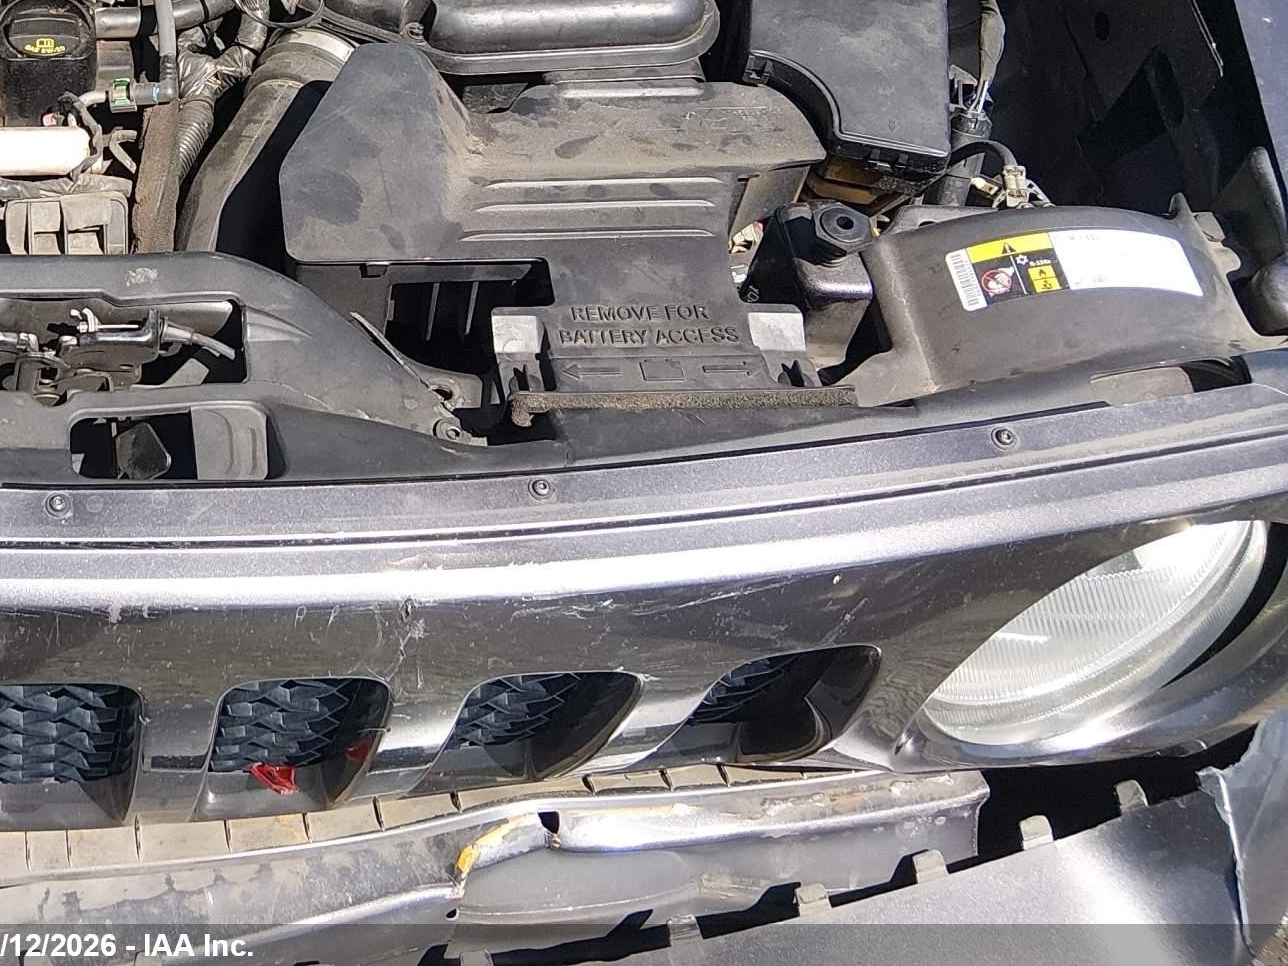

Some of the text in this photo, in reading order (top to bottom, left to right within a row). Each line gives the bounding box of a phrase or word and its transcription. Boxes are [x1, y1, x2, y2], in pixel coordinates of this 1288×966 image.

[570, 304, 710, 322] REMOVE FOR
[558, 325, 741, 346] BATTERY ACCESS
